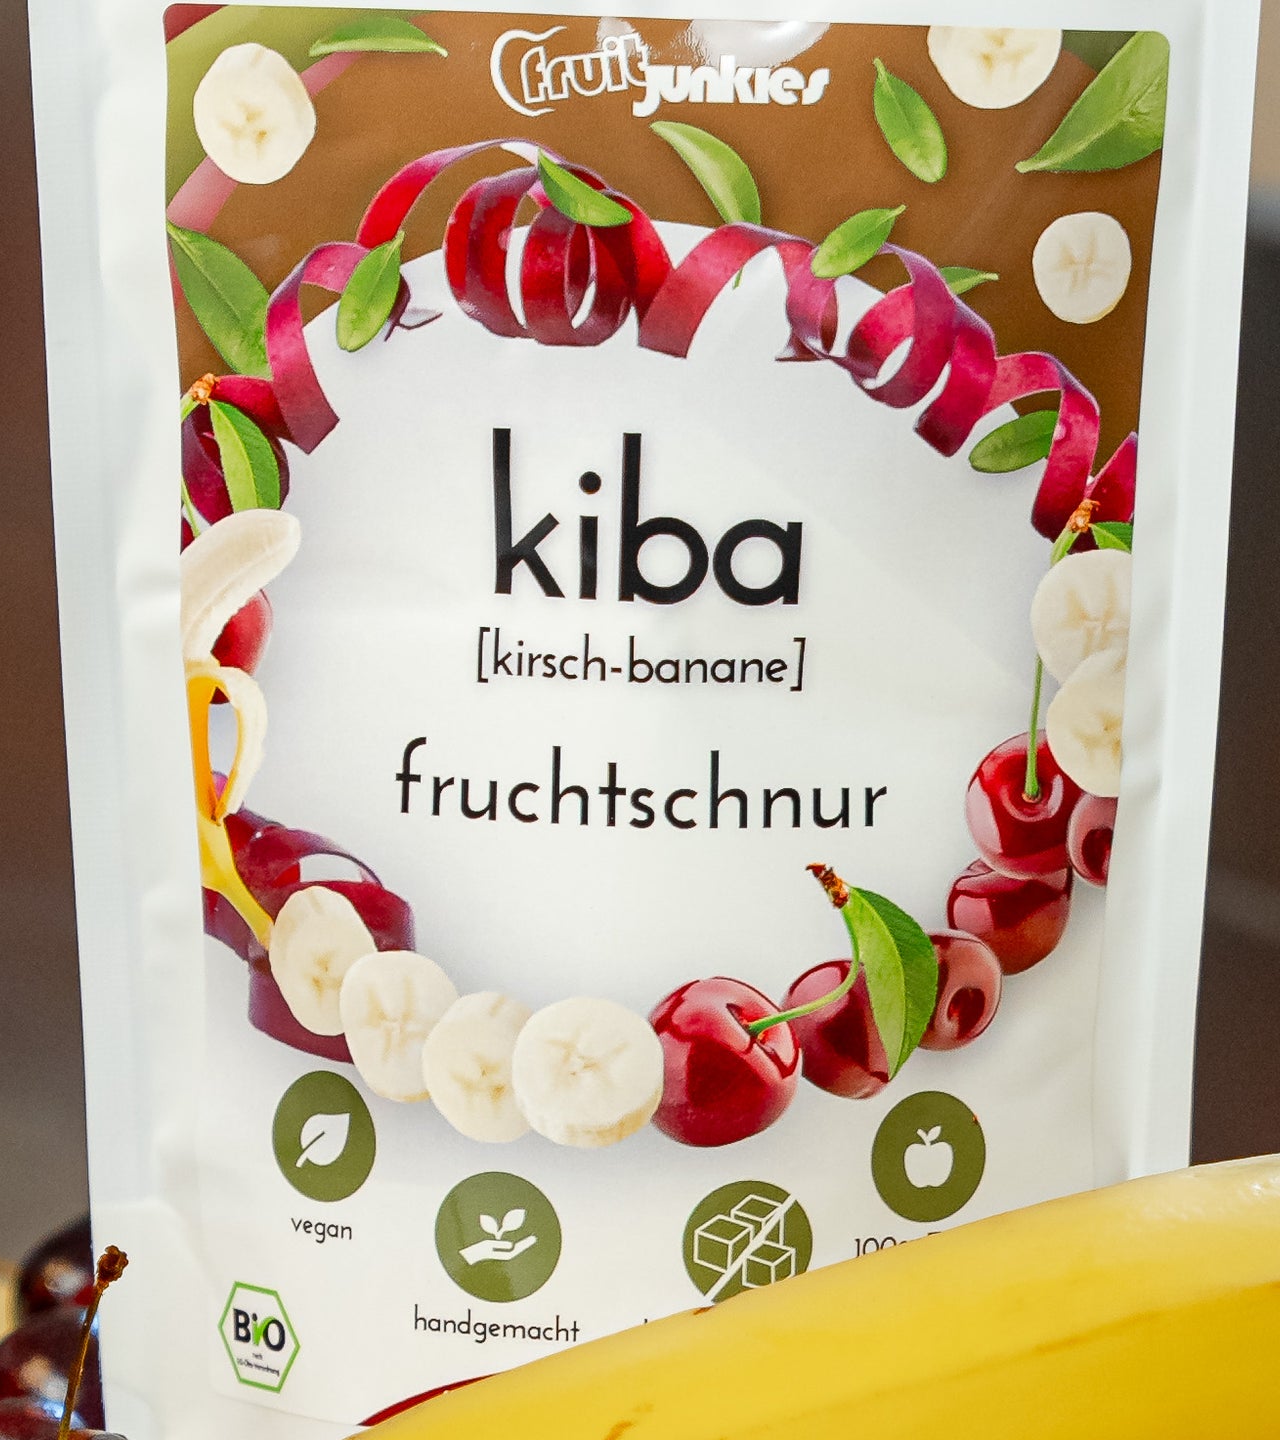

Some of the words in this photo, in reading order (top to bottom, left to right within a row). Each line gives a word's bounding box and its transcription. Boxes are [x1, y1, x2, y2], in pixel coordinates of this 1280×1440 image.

[519, 31, 651, 104] fruit
[632, 54, 830, 117] junkies
[492, 427, 803, 606] kiba
[476, 626, 806, 691] [kirsch-banane]
[395, 736, 887, 828] fruchtschnur
[291, 1217, 352, 1243] vegan
[854, 1235, 908, 1258] 100
[413, 1303, 580, 1344] handgemacht
